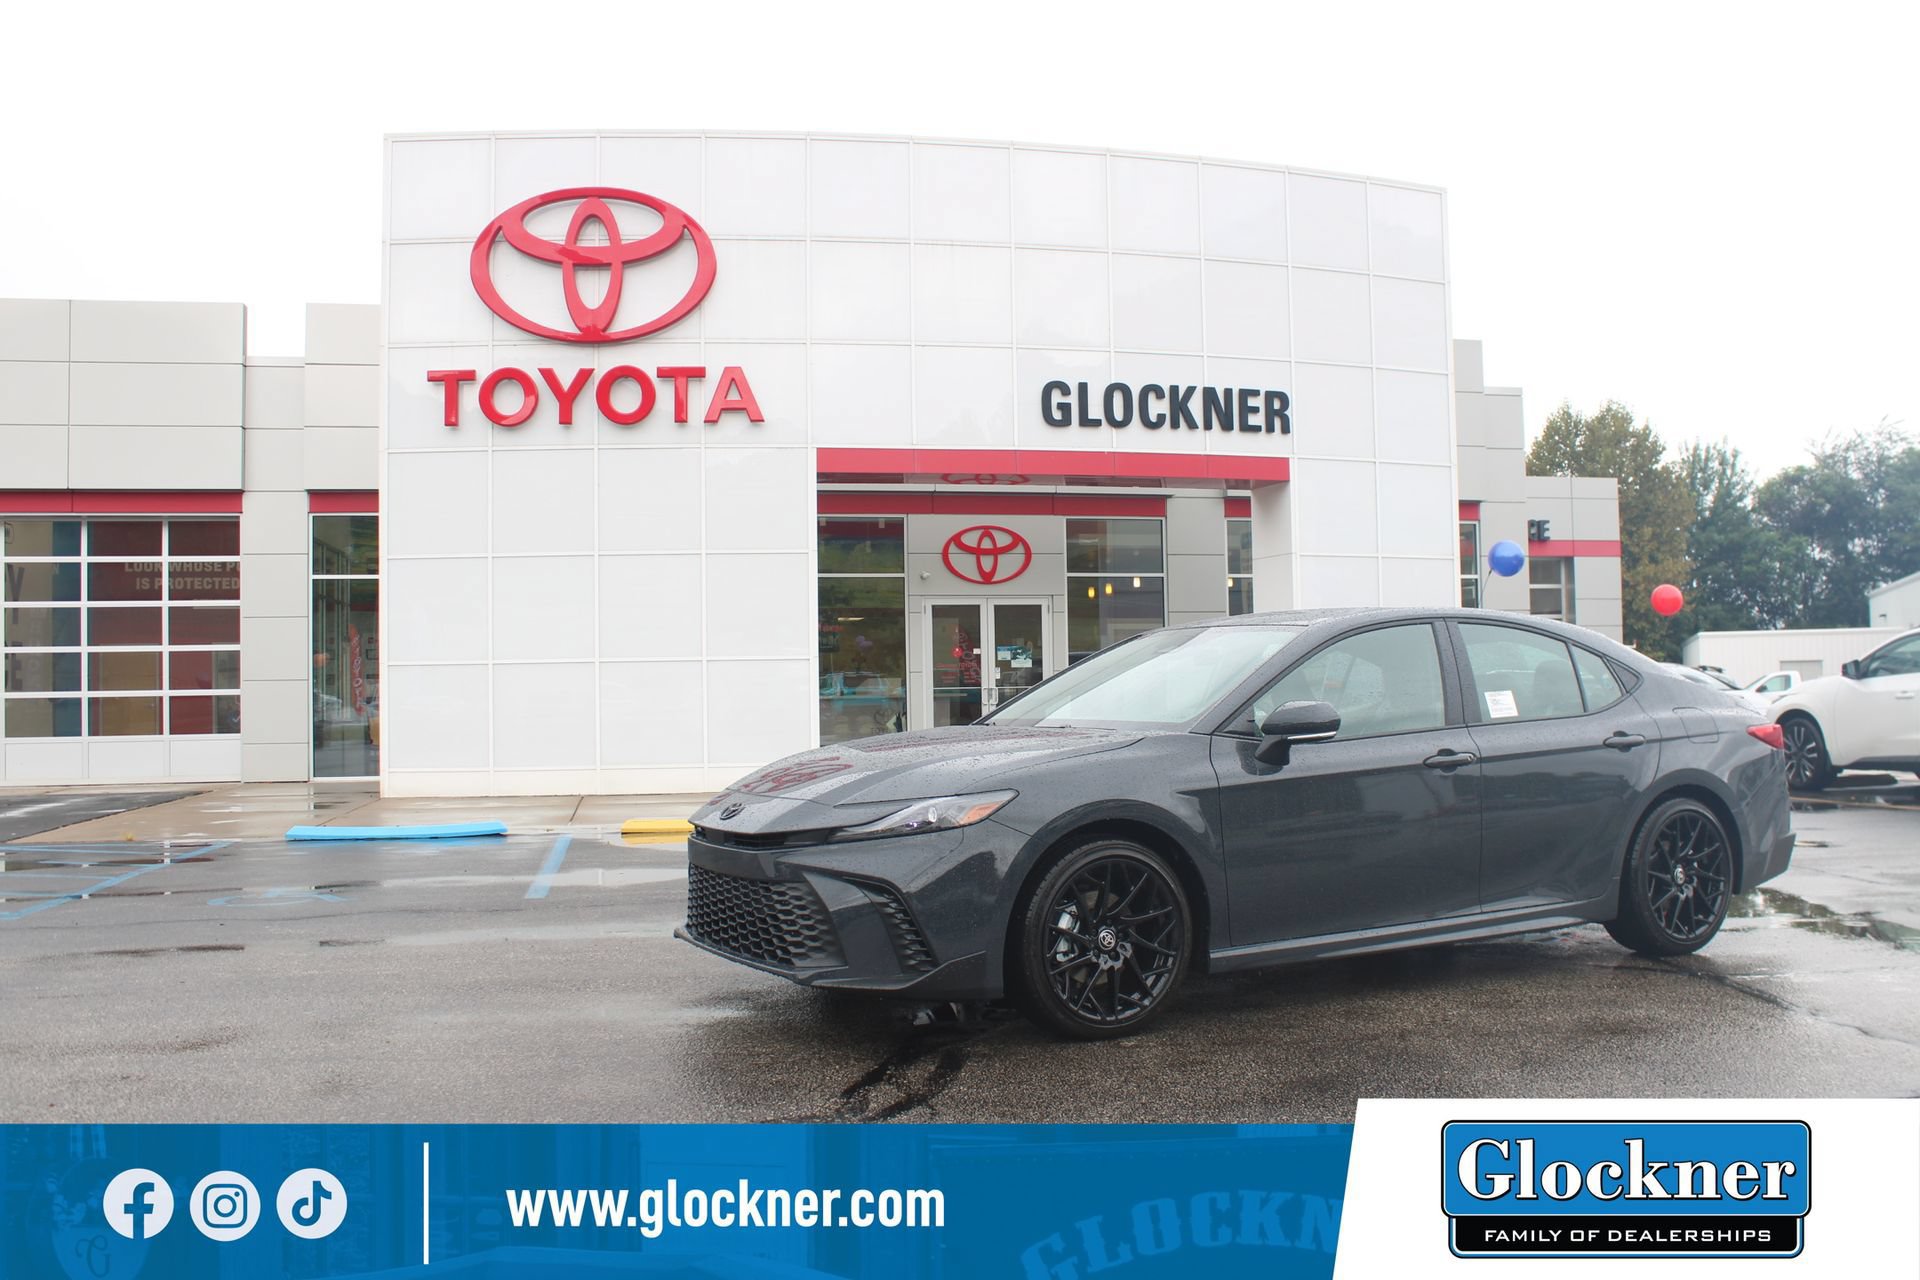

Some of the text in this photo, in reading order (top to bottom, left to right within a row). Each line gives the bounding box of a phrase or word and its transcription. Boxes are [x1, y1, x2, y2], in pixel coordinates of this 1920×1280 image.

[427, 365, 765, 428] TOYOTA
[1041, 381, 1291, 435] GLOCKNER
[168, 561, 223, 572] WHOSE
[135, 577, 150, 590] IS
